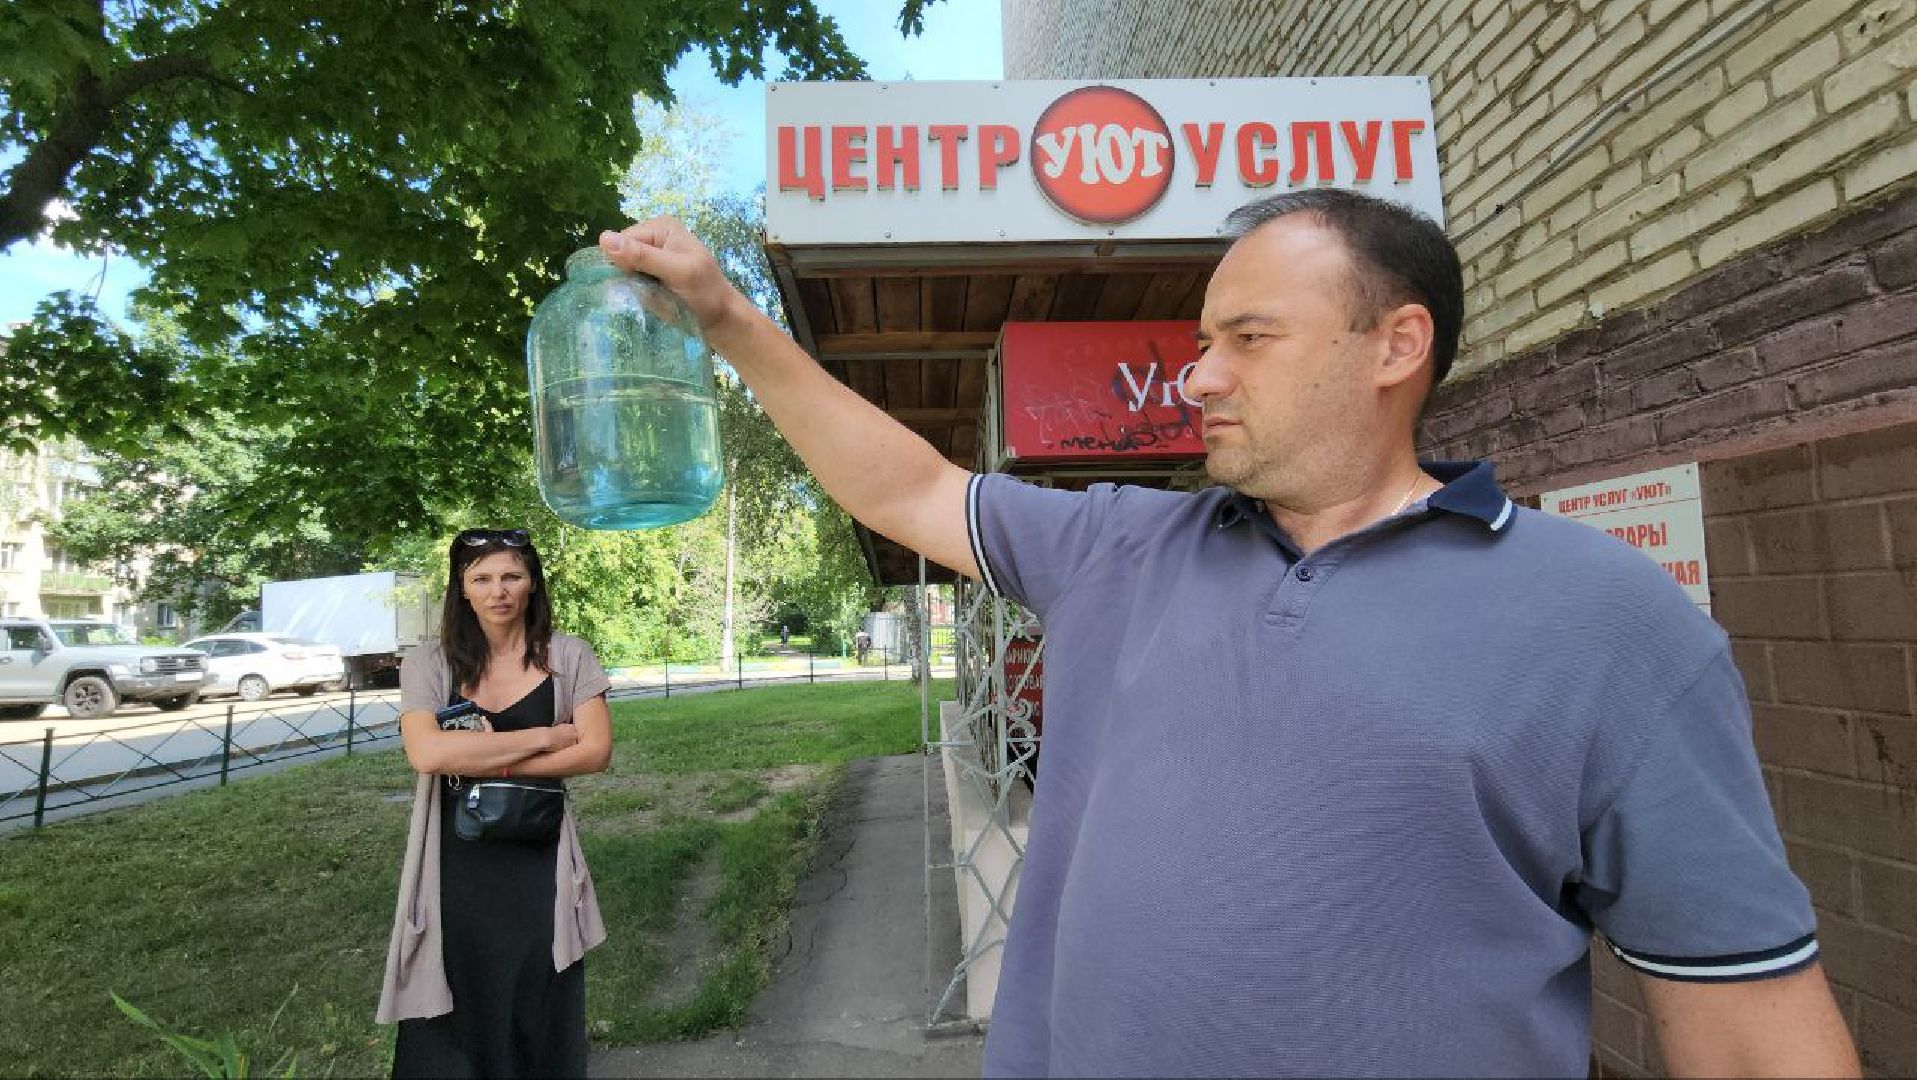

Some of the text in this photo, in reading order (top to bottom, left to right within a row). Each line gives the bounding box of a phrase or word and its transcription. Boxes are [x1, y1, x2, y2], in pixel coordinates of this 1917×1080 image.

[778, 119, 1426, 202] ЦЕНТР УЮТ УСЛУГ
[1558, 498, 1591, 515] ЦЕНТР
[1593, 490, 1628, 508] УСЛУГ
